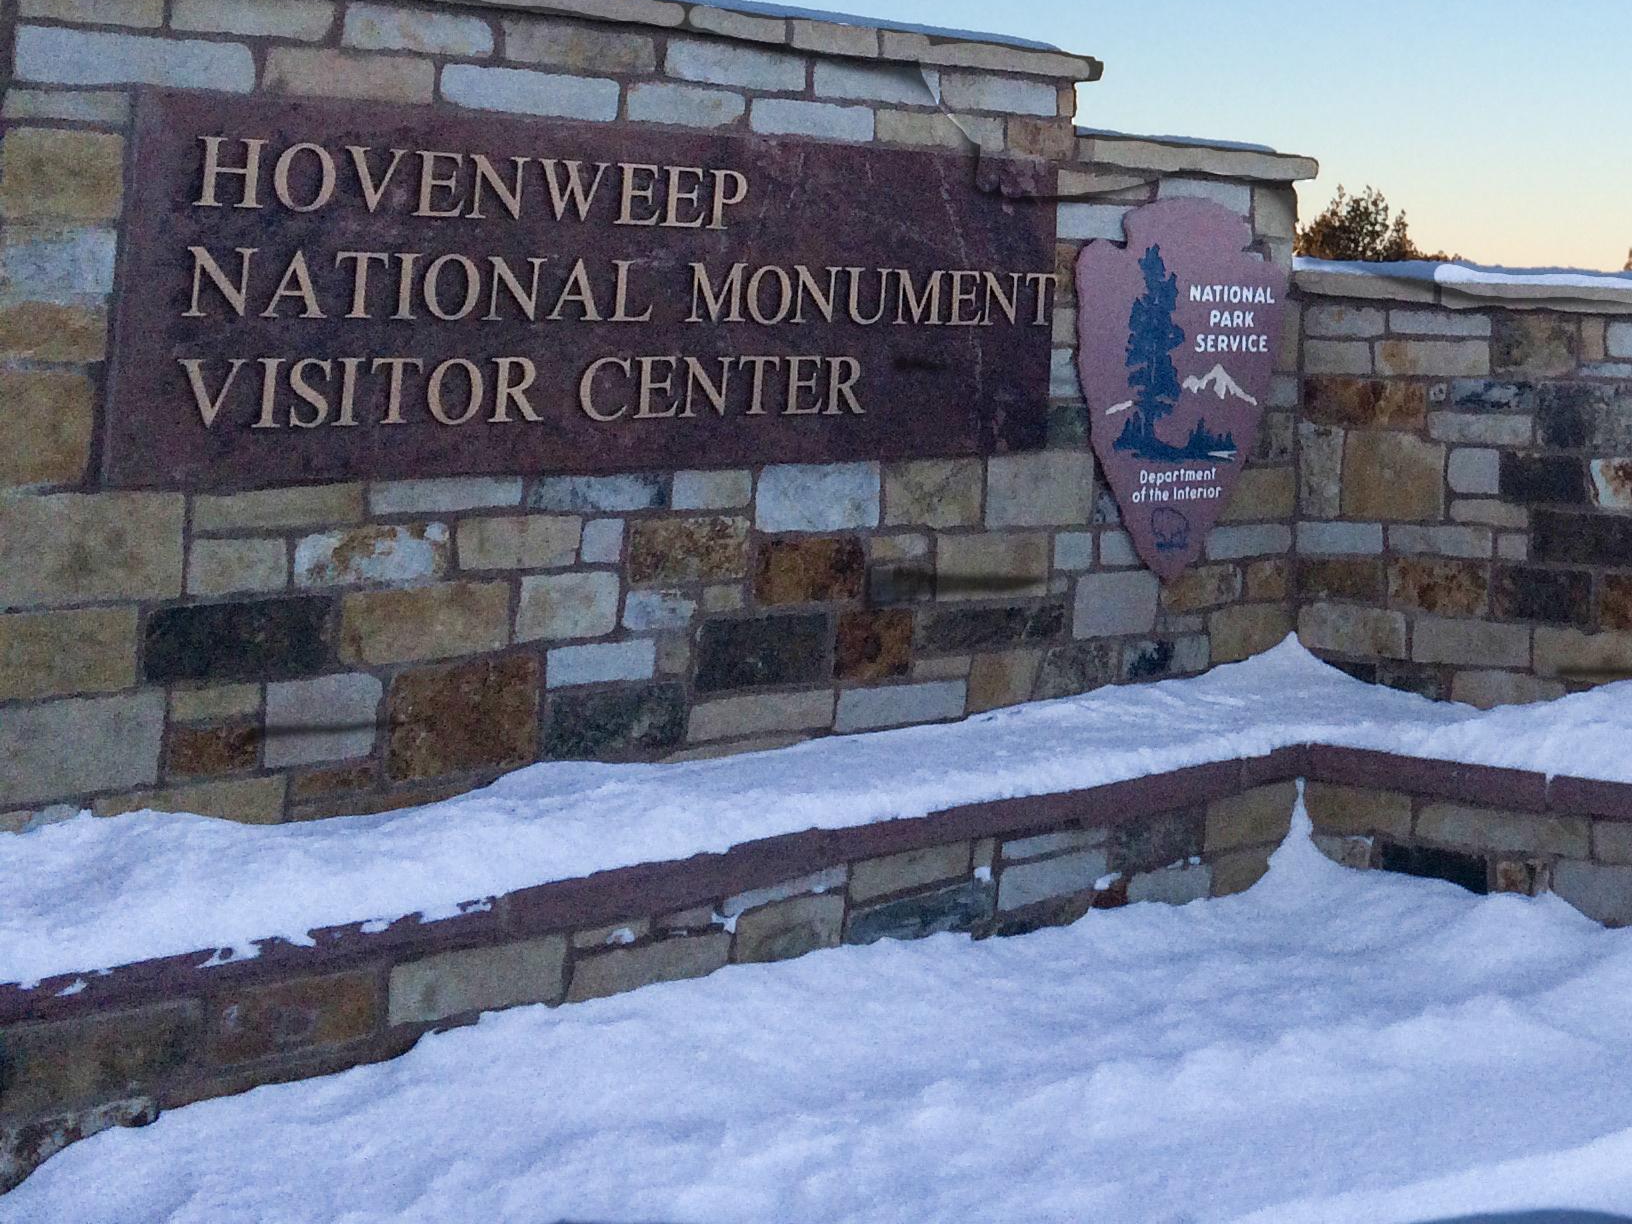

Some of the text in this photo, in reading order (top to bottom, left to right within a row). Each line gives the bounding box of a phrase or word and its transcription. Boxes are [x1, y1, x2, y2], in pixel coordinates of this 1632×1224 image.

[194, 134, 748, 230] HOVENWEEP
[181, 245, 1057, 327] NATIONAL MONUMENT
[1189, 284, 1275, 304] NATIONAL
[1209, 309, 1254, 328] PARK
[1194, 333, 1268, 353] SERVICE
[176, 355, 867, 429] VISITOR CENTER
[1139, 466, 1217, 486] Department
[1132, 484, 1222, 503] of the Interior
